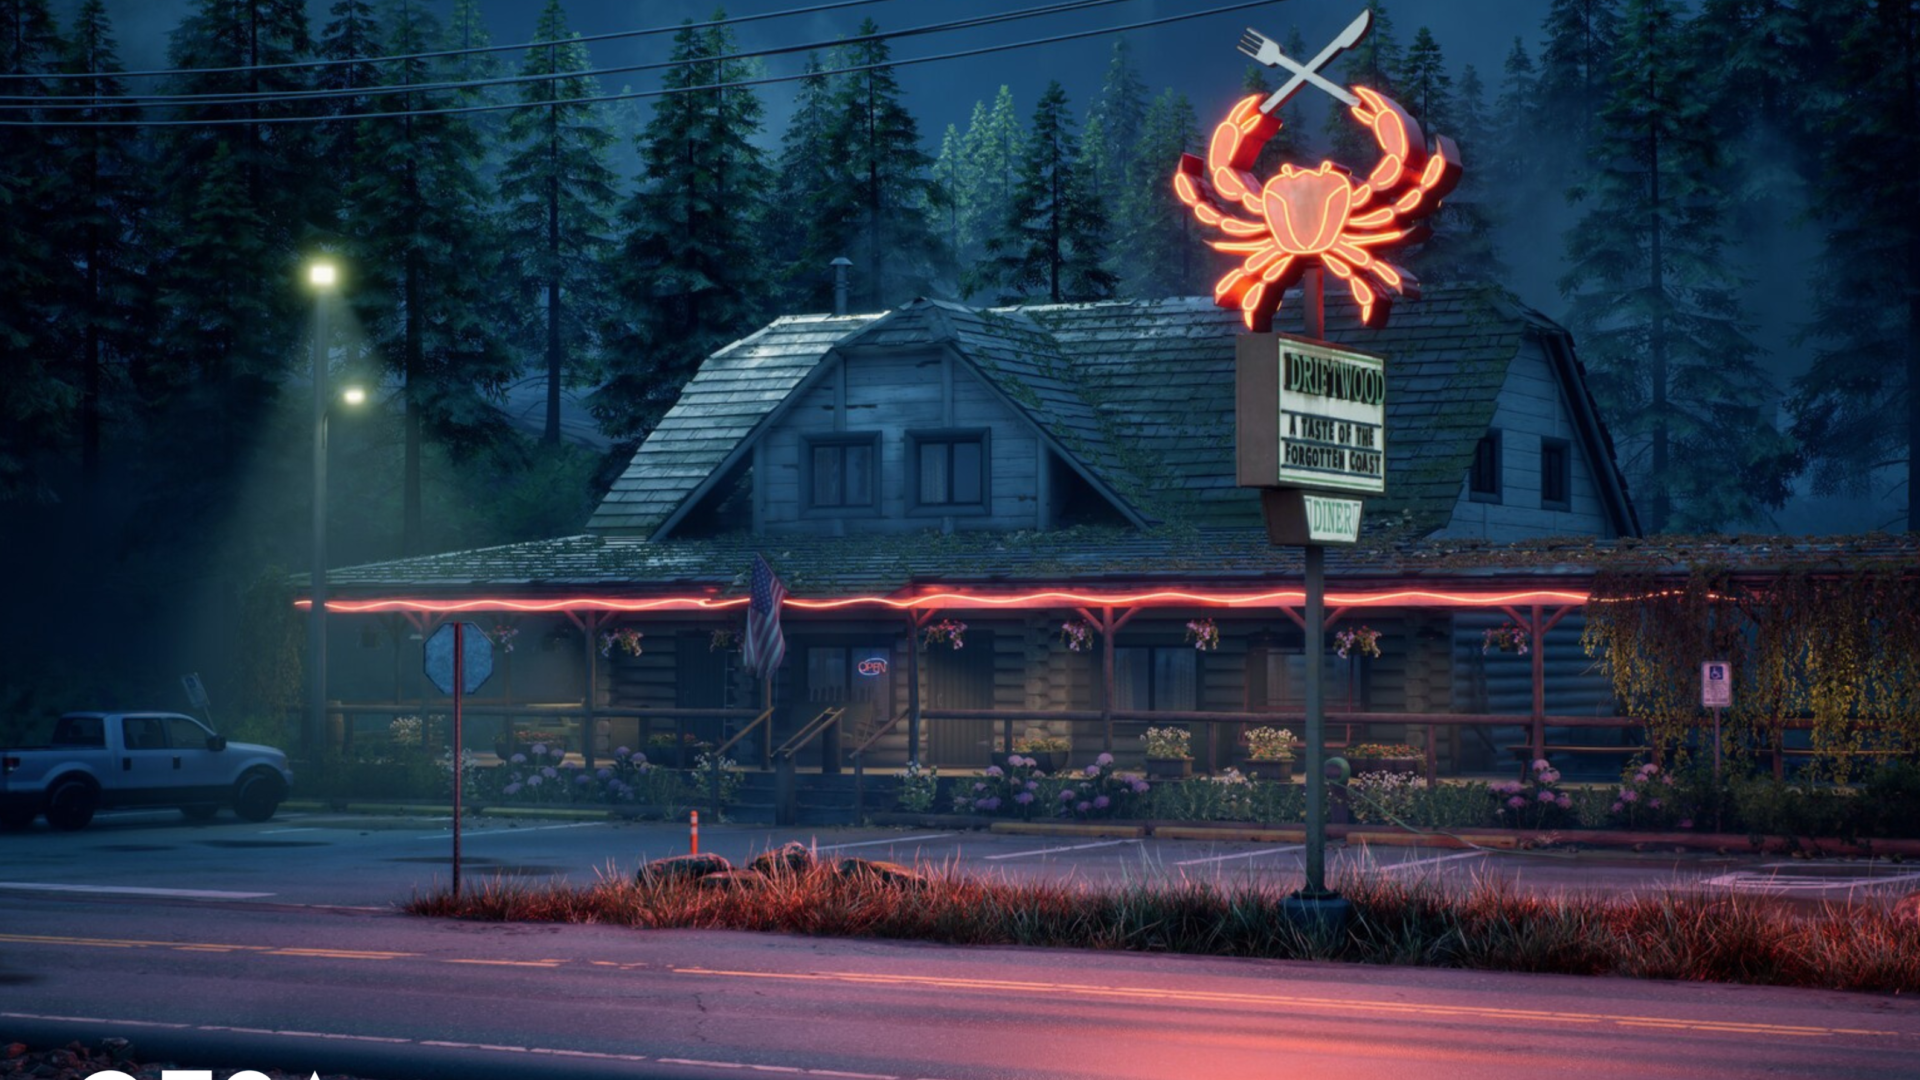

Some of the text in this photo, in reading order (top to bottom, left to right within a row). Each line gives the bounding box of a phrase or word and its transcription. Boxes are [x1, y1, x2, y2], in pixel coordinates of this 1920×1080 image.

[1289, 353, 1385, 406] DRIFTWOOD
[1289, 415, 1375, 448] A TASTE OF THE
[1285, 443, 1381, 475] FORGOTTEN COAST
[1313, 499, 1353, 535] DINER
[858, 661, 886, 673] OPEN
